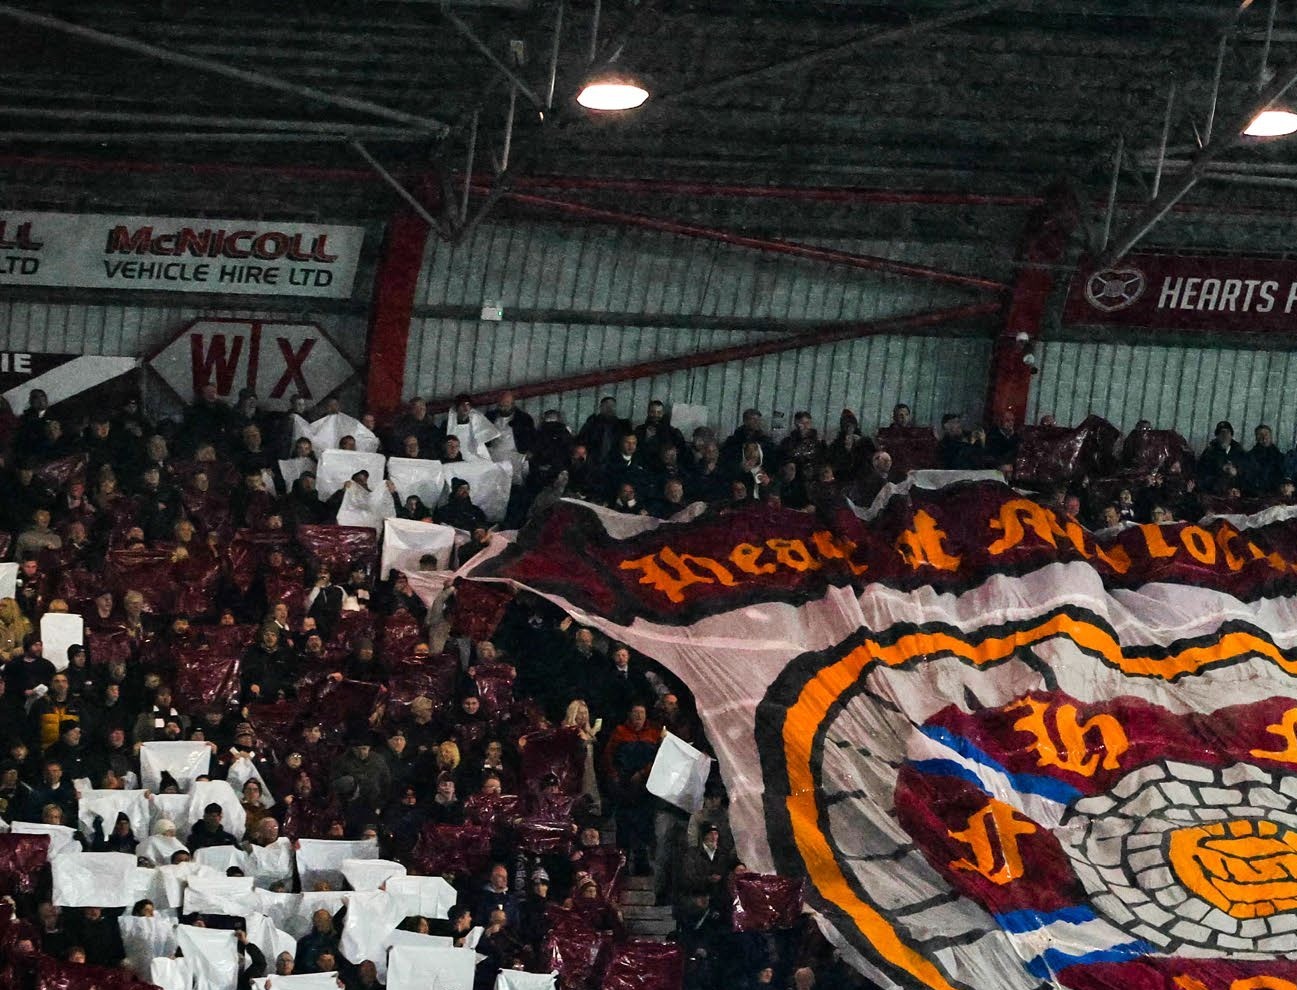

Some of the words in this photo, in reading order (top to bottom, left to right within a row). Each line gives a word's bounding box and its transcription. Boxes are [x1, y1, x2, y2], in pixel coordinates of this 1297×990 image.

[104, 260, 209, 282] VEHICLE
[219, 264, 279, 285] HIRE
[289, 268, 333, 287] LTD
[1158, 276, 1278, 314] HEARTS
[190, 333, 244, 397] W
[269, 338, 317, 400] X
